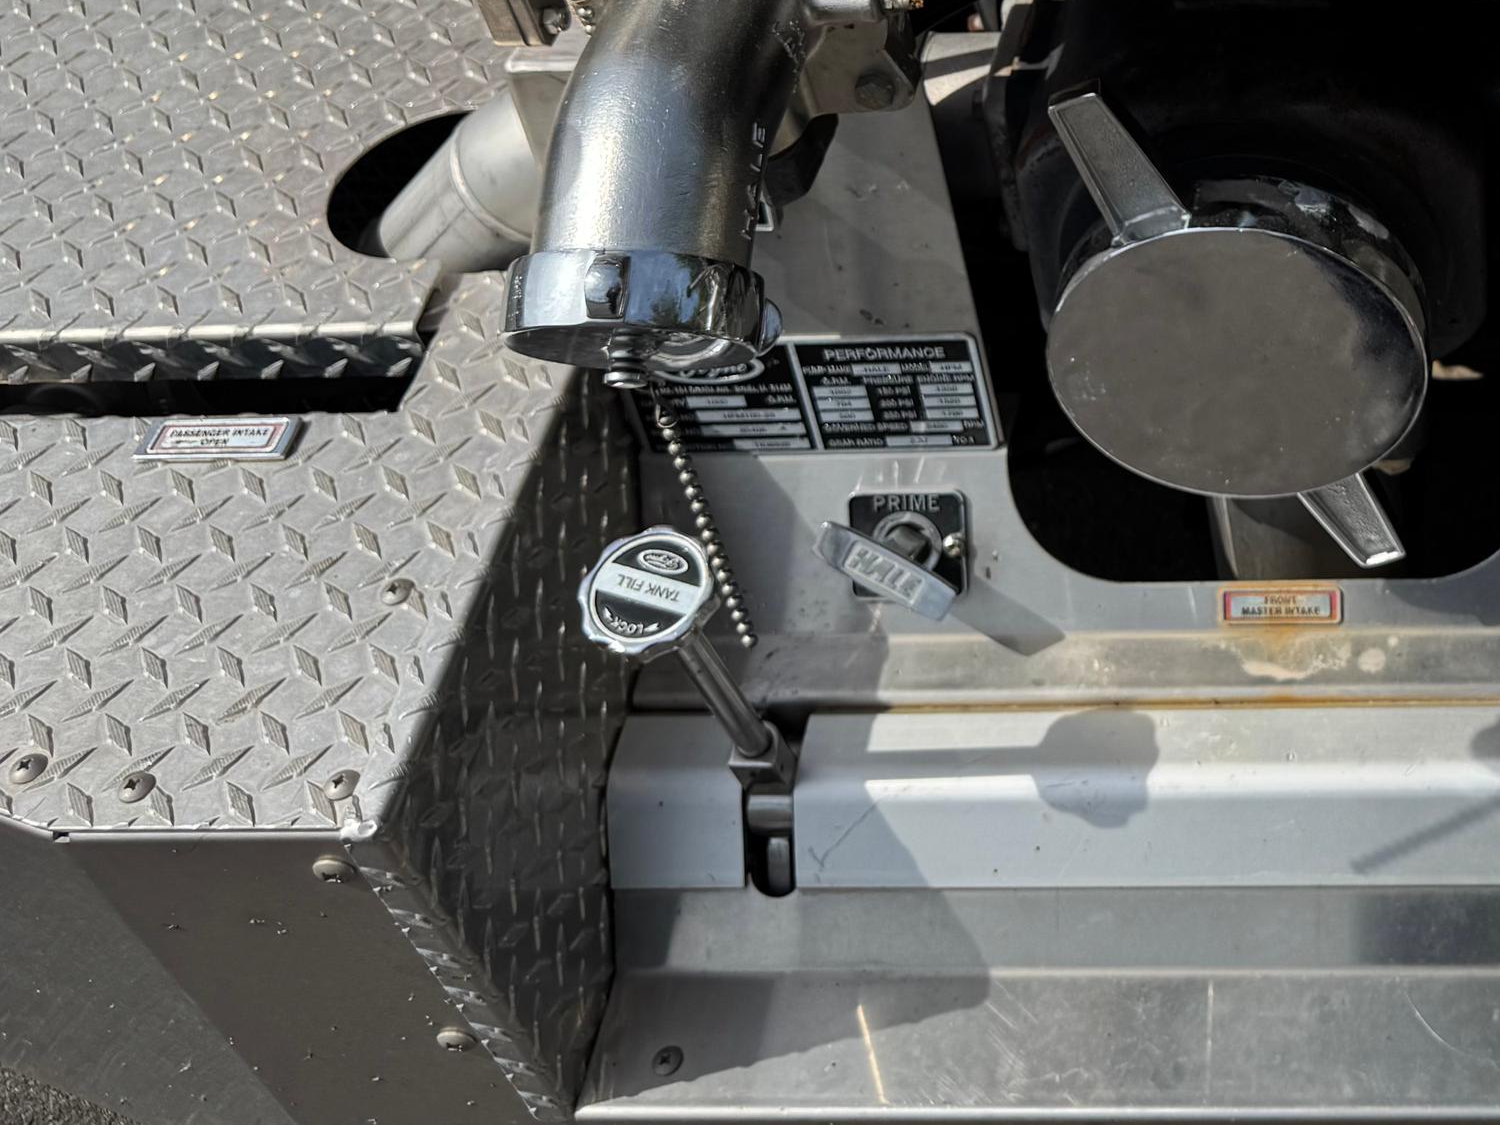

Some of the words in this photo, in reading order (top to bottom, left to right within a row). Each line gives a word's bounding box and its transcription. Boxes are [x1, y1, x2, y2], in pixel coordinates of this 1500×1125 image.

[824, 347, 945, 361] PERFORMANCE
[170, 429, 230, 437] PASSENGER
[873, 495, 940, 512] PRIME
[618, 574, 644, 591] FILL
[645, 585, 680, 602] TANK
[1242, 607, 1282, 615] MASTER
